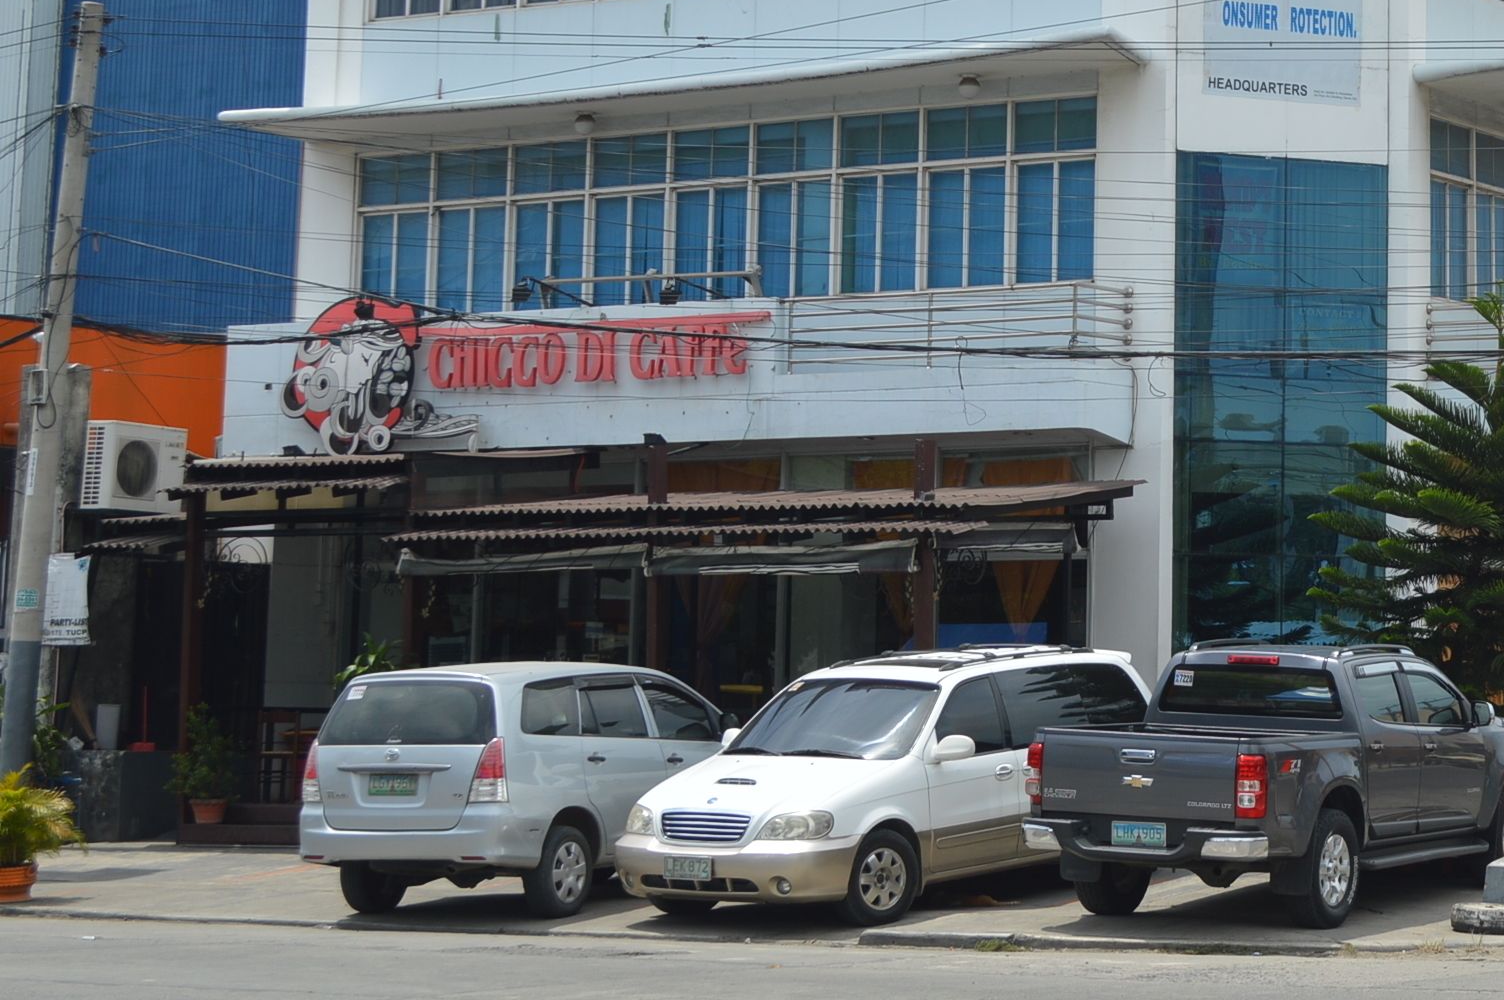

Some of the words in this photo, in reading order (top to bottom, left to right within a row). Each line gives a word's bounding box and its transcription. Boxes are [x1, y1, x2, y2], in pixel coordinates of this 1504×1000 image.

[1222, 0, 1279, 31] ONSUMER
[1290, 6, 1358, 39] ROTECTION.
[1207, 76, 1308, 97] HEADQUARTERS
[427, 332, 566, 390] CHICCO
[575, 330, 617, 385] DI
[1115, 825, 1136, 839] LHK
[1142, 827, 1163, 840] 905
[688, 860, 709, 874] 872
